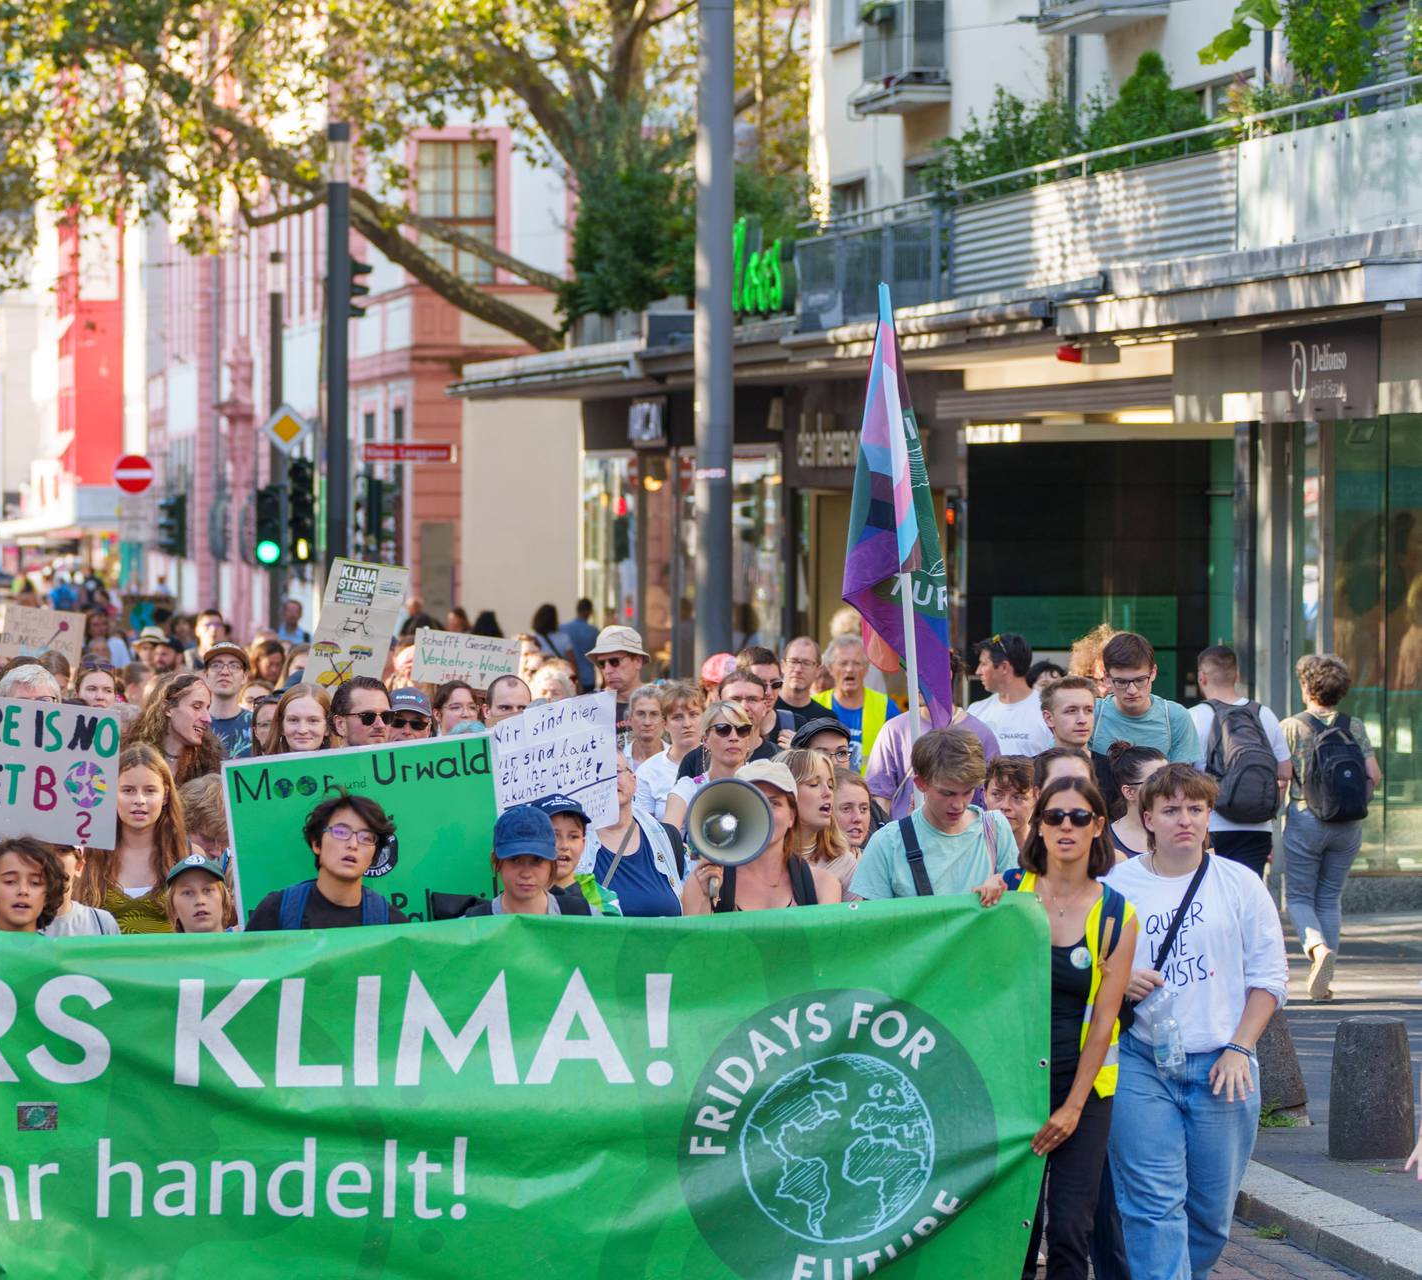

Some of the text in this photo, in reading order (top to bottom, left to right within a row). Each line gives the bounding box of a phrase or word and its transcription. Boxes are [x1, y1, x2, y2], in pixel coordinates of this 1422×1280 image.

[1311, 343, 1347, 372] Delfonso
[337, 578, 376, 594] STREIK
[341, 565, 378, 582] KLIMA
[421, 634, 460, 648] schafft
[465, 636, 503, 652] Gesetze
[34, 710, 63, 752] IS
[67, 714, 120, 758] NO
[532, 707, 564, 736] sind
[344, 775, 367, 790] und
[372, 739, 491, 786] Urwald
[523, 743, 555, 766] sind
[33, 765, 58, 811] B
[364, 863, 393, 877] UTURE
[1150, 929, 1189, 964] LVE
[173, 966, 674, 1088] KLIMA!
[689, 1001, 936, 1155] FRIDAYS FOR
[96, 1136, 468, 1221] handelt!
